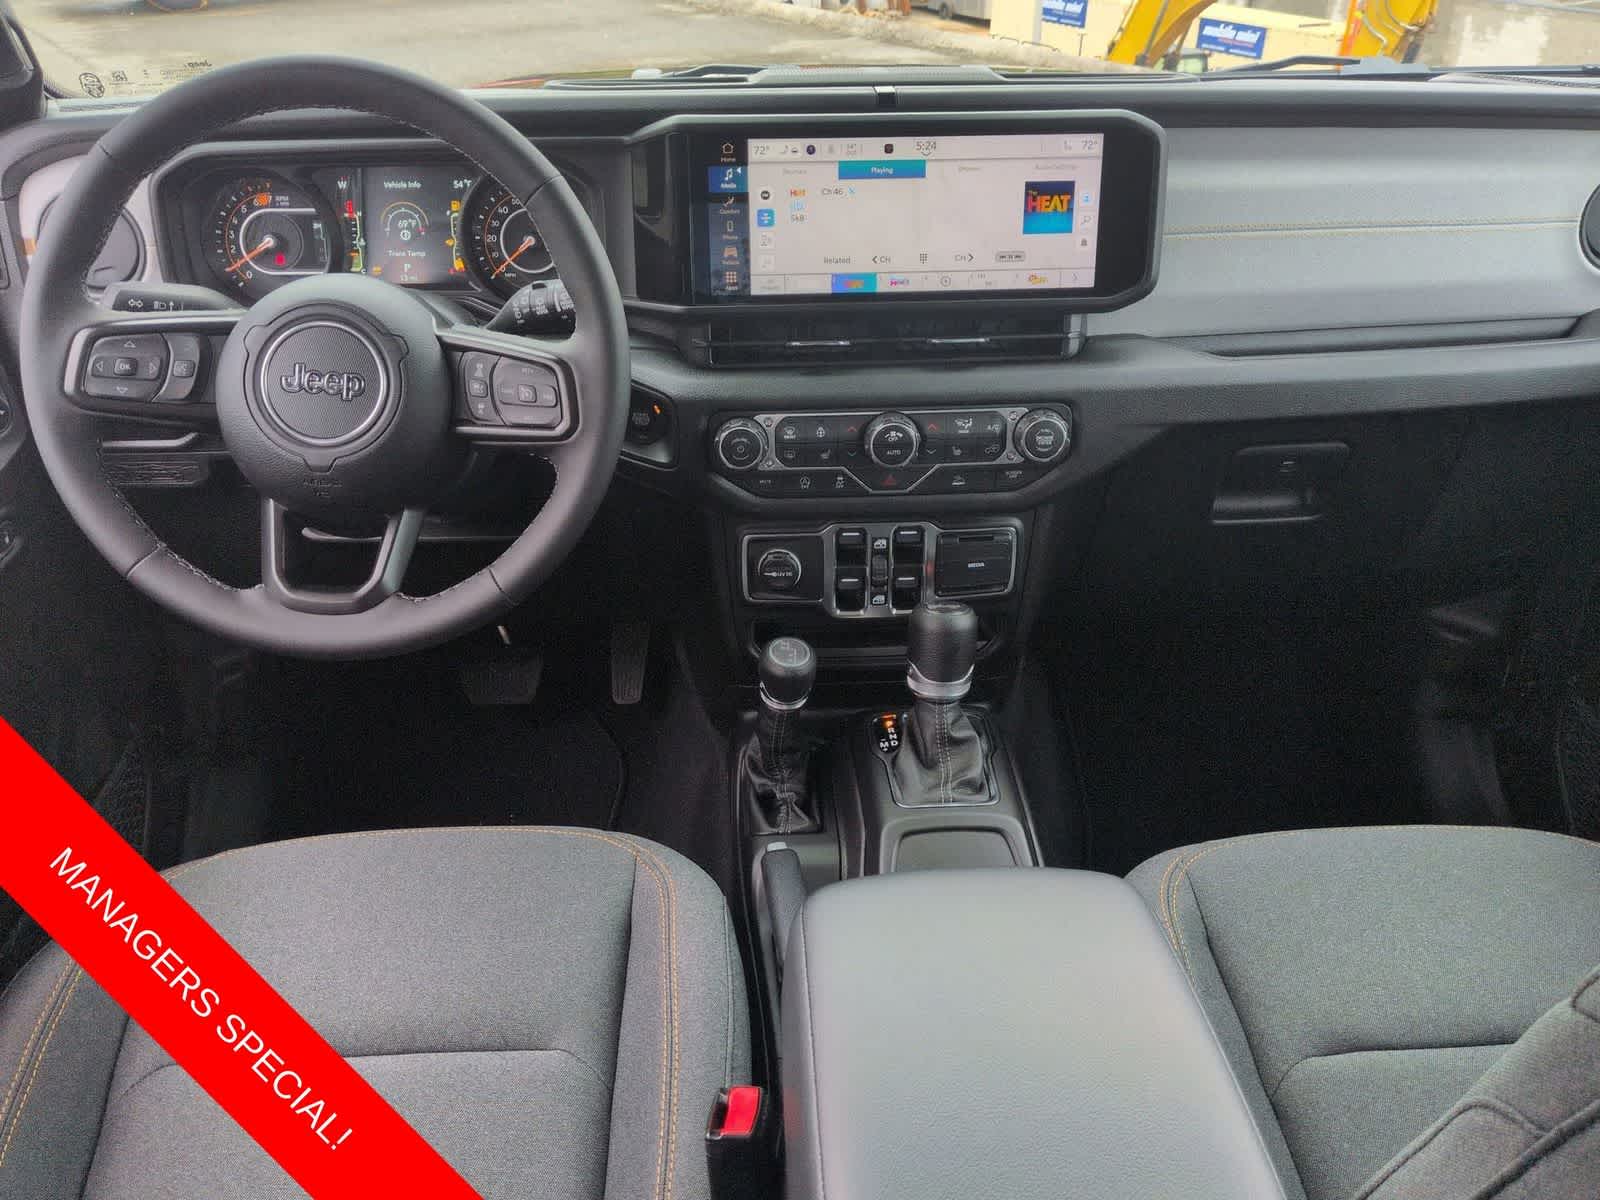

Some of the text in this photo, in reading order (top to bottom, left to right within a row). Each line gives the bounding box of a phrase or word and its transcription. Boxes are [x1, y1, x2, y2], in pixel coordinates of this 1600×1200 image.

[916, 140, 937, 151] 5:24
[871, 166, 893, 175] Playing
[383, 180, 422, 189] Vehicle Info
[1026, 193, 1071, 213] HEAT
[486, 234, 498, 243] 20
[823, 256, 851, 264] Related
[246, 270, 253, 279] 0
[119, 362, 131, 371] OK
[280, 362, 366, 402] Jeep
